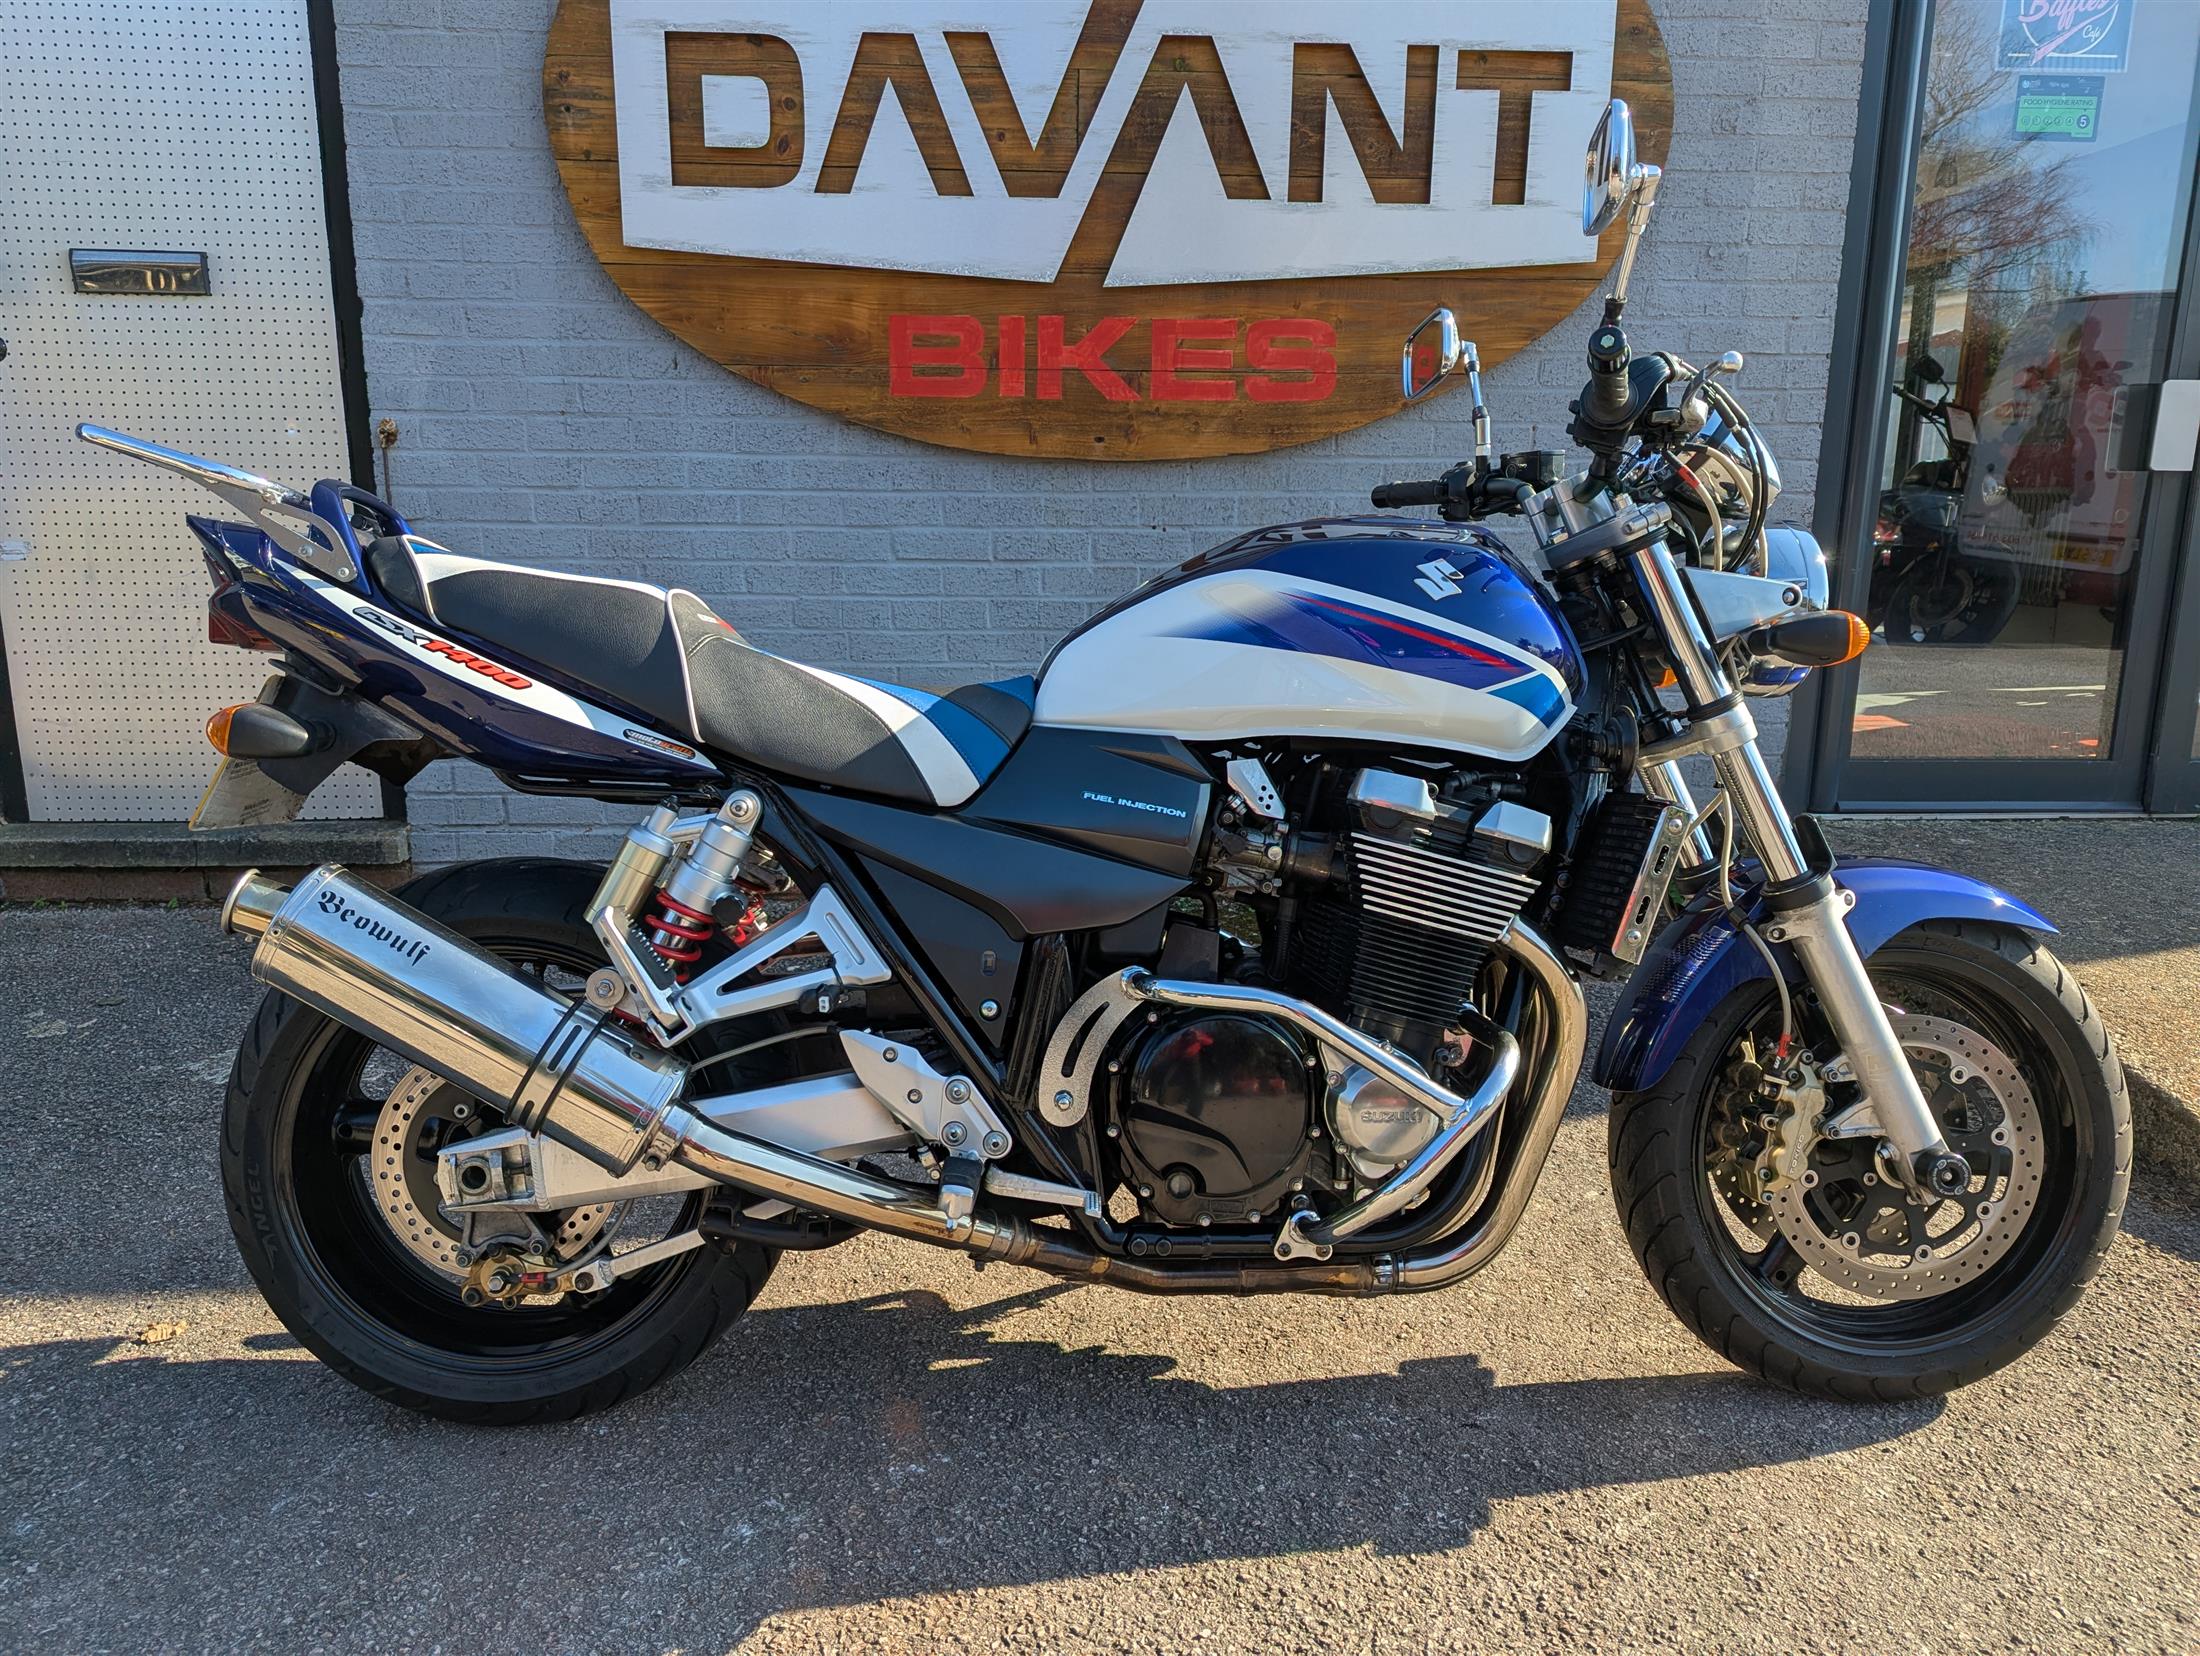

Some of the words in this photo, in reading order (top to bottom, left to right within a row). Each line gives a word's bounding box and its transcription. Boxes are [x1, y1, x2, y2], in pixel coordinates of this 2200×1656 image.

[664, 2, 1573, 206] DAVANT
[2023, 98, 2043, 106] FOOD
[2079, 115, 2087, 127] 5
[888, 314, 1338, 401] BIKES
[1083, 792, 1115, 804] FUEL
[1118, 798, 1187, 818] INJECTION
[317, 890, 432, 967] Beowulf
[1360, 1110, 1422, 1124] SUZUKI
[1789, 1134, 1805, 1174] TOKICO
